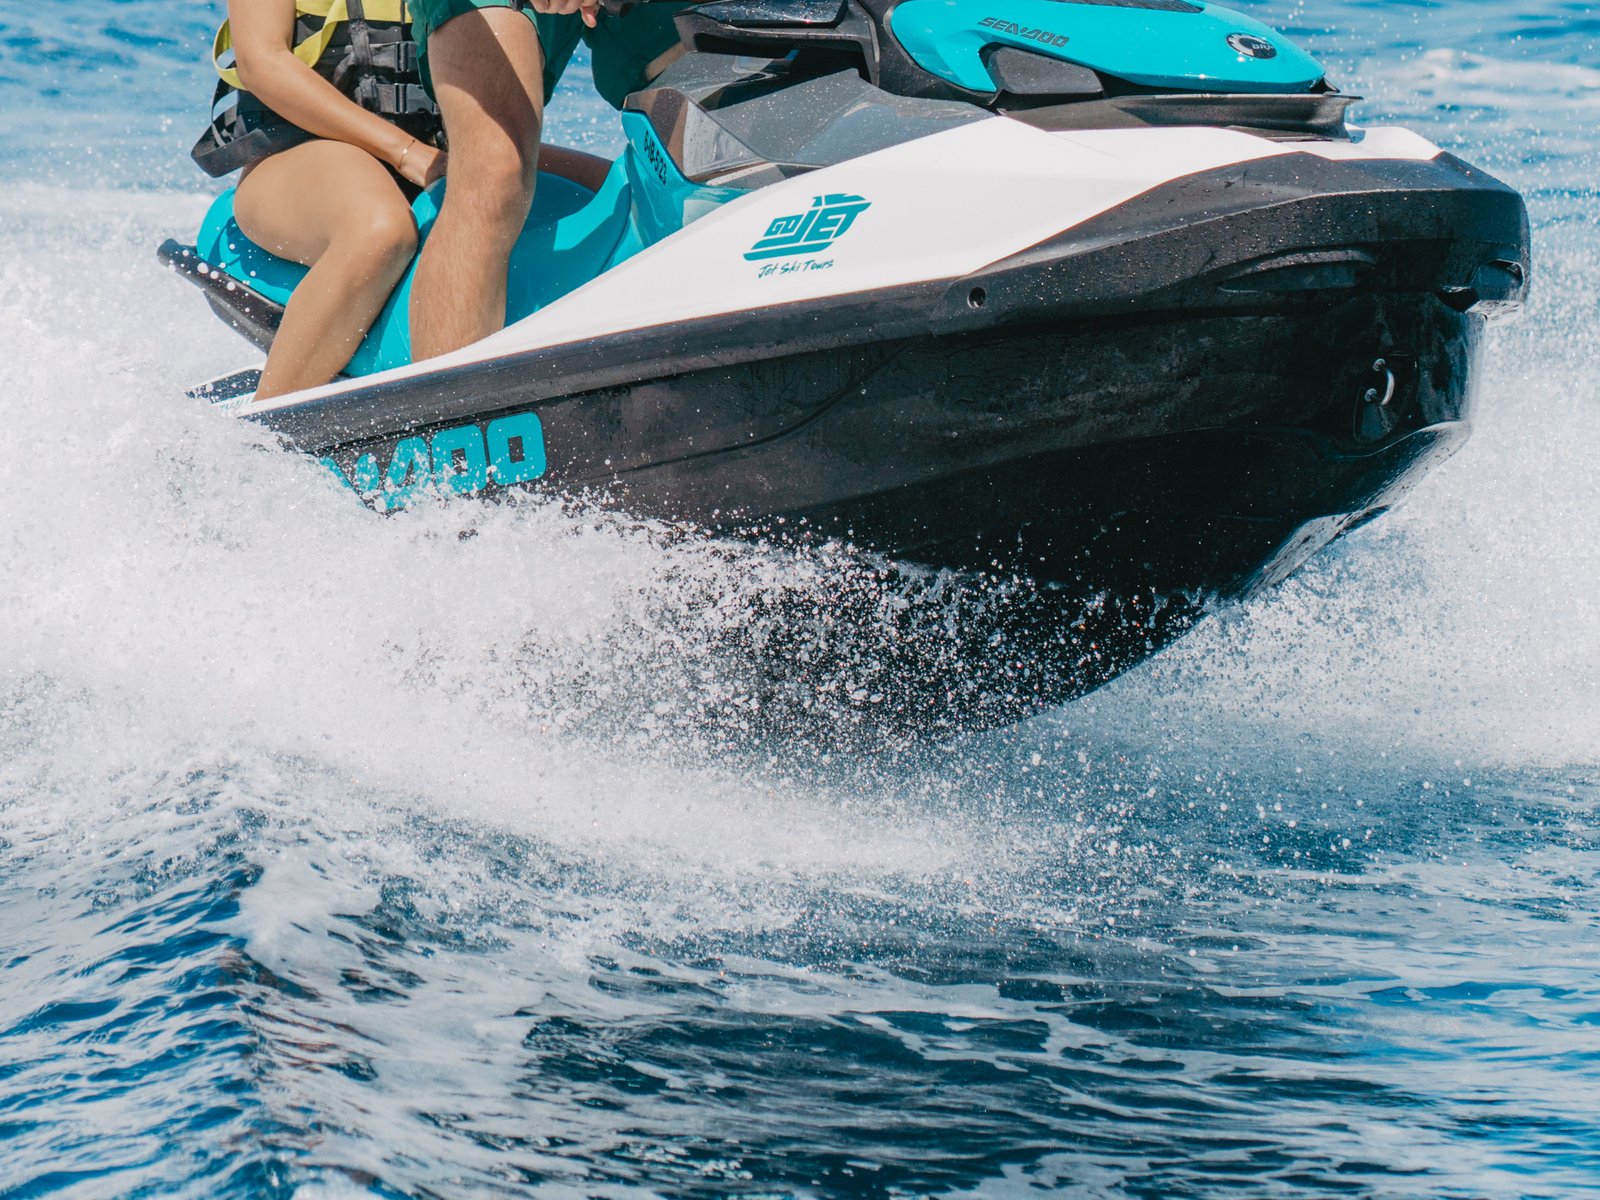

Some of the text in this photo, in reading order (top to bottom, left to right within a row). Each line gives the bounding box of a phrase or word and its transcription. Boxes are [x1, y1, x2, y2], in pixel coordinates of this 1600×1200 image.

[758, 259, 834, 279] Jet Ski Tours
